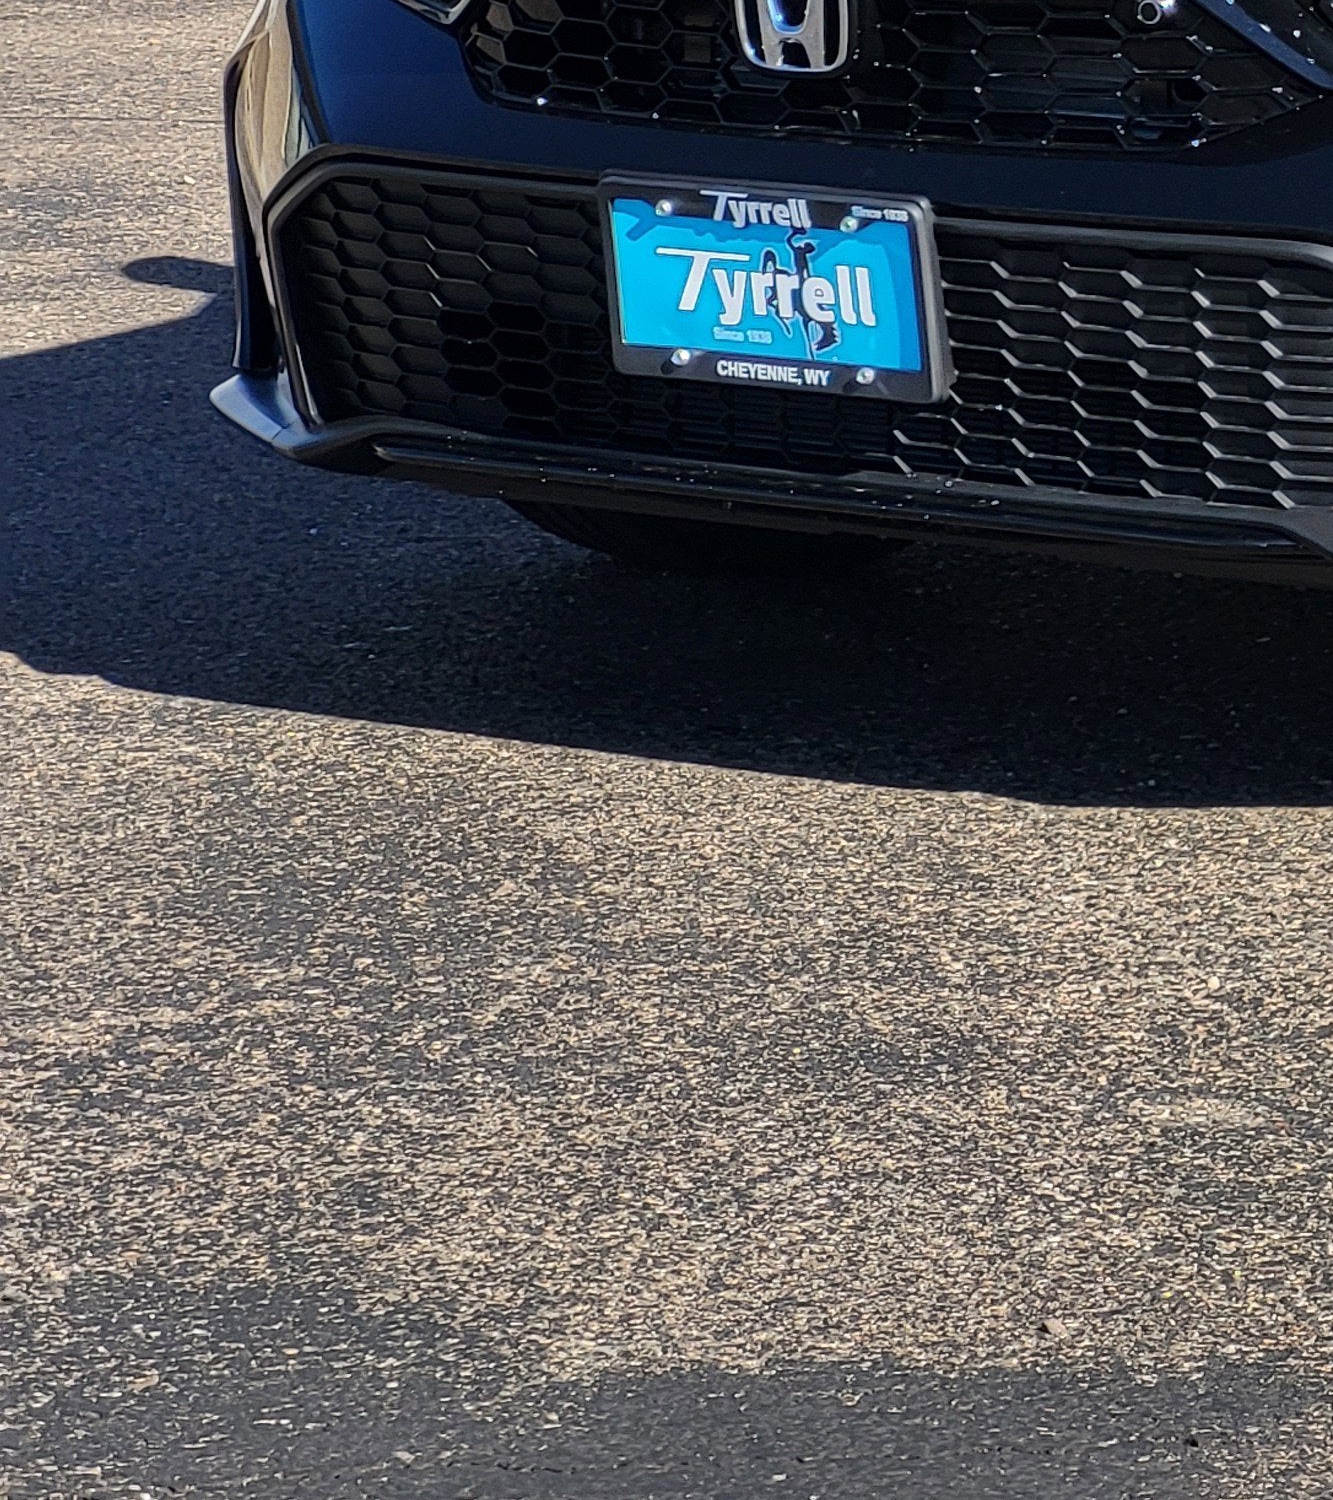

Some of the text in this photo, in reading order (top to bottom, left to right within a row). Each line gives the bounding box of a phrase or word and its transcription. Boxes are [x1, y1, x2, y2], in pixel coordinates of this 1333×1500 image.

[700, 189, 812, 229] Tyrrell
[656, 246, 877, 327] Tyrrell
[716, 359, 830, 386] CHEYENNE, WY
